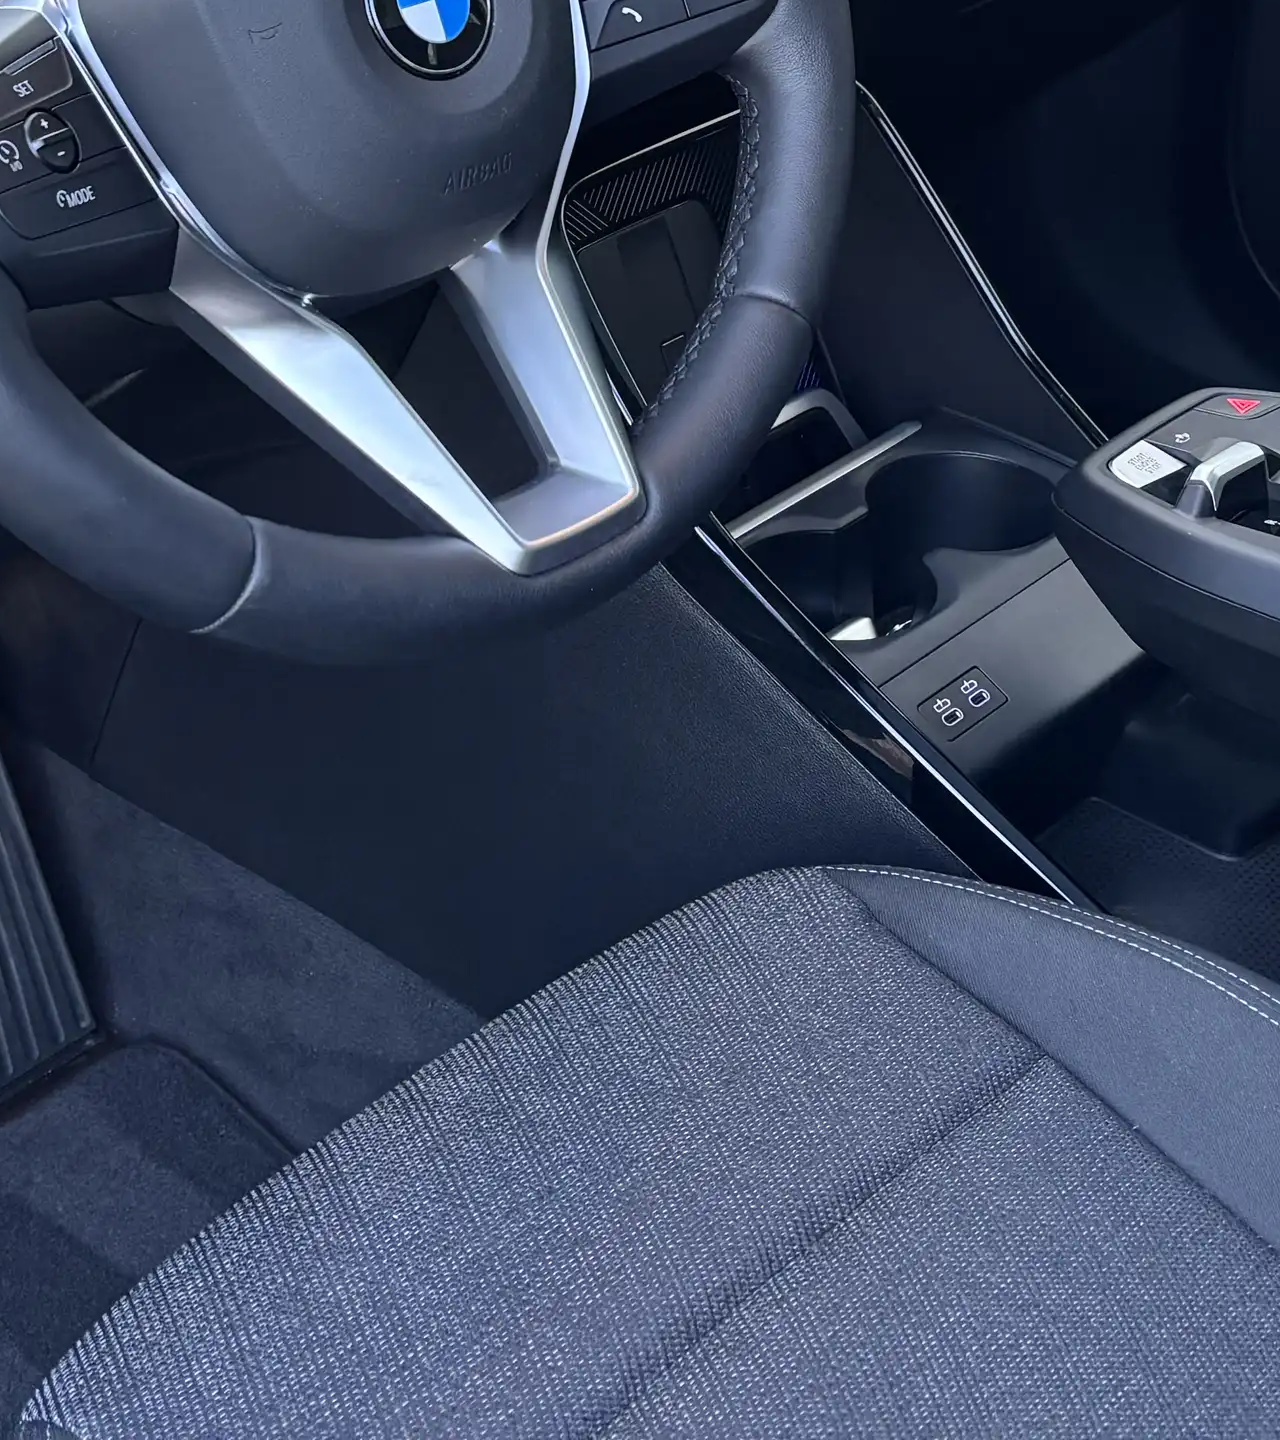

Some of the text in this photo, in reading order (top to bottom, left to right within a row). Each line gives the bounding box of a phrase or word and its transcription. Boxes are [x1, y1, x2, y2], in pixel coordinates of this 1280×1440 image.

[12, 79, 35, 98] SET
[444, 151, 512, 196] AIRBAG
[67, 185, 96, 208] MODE
